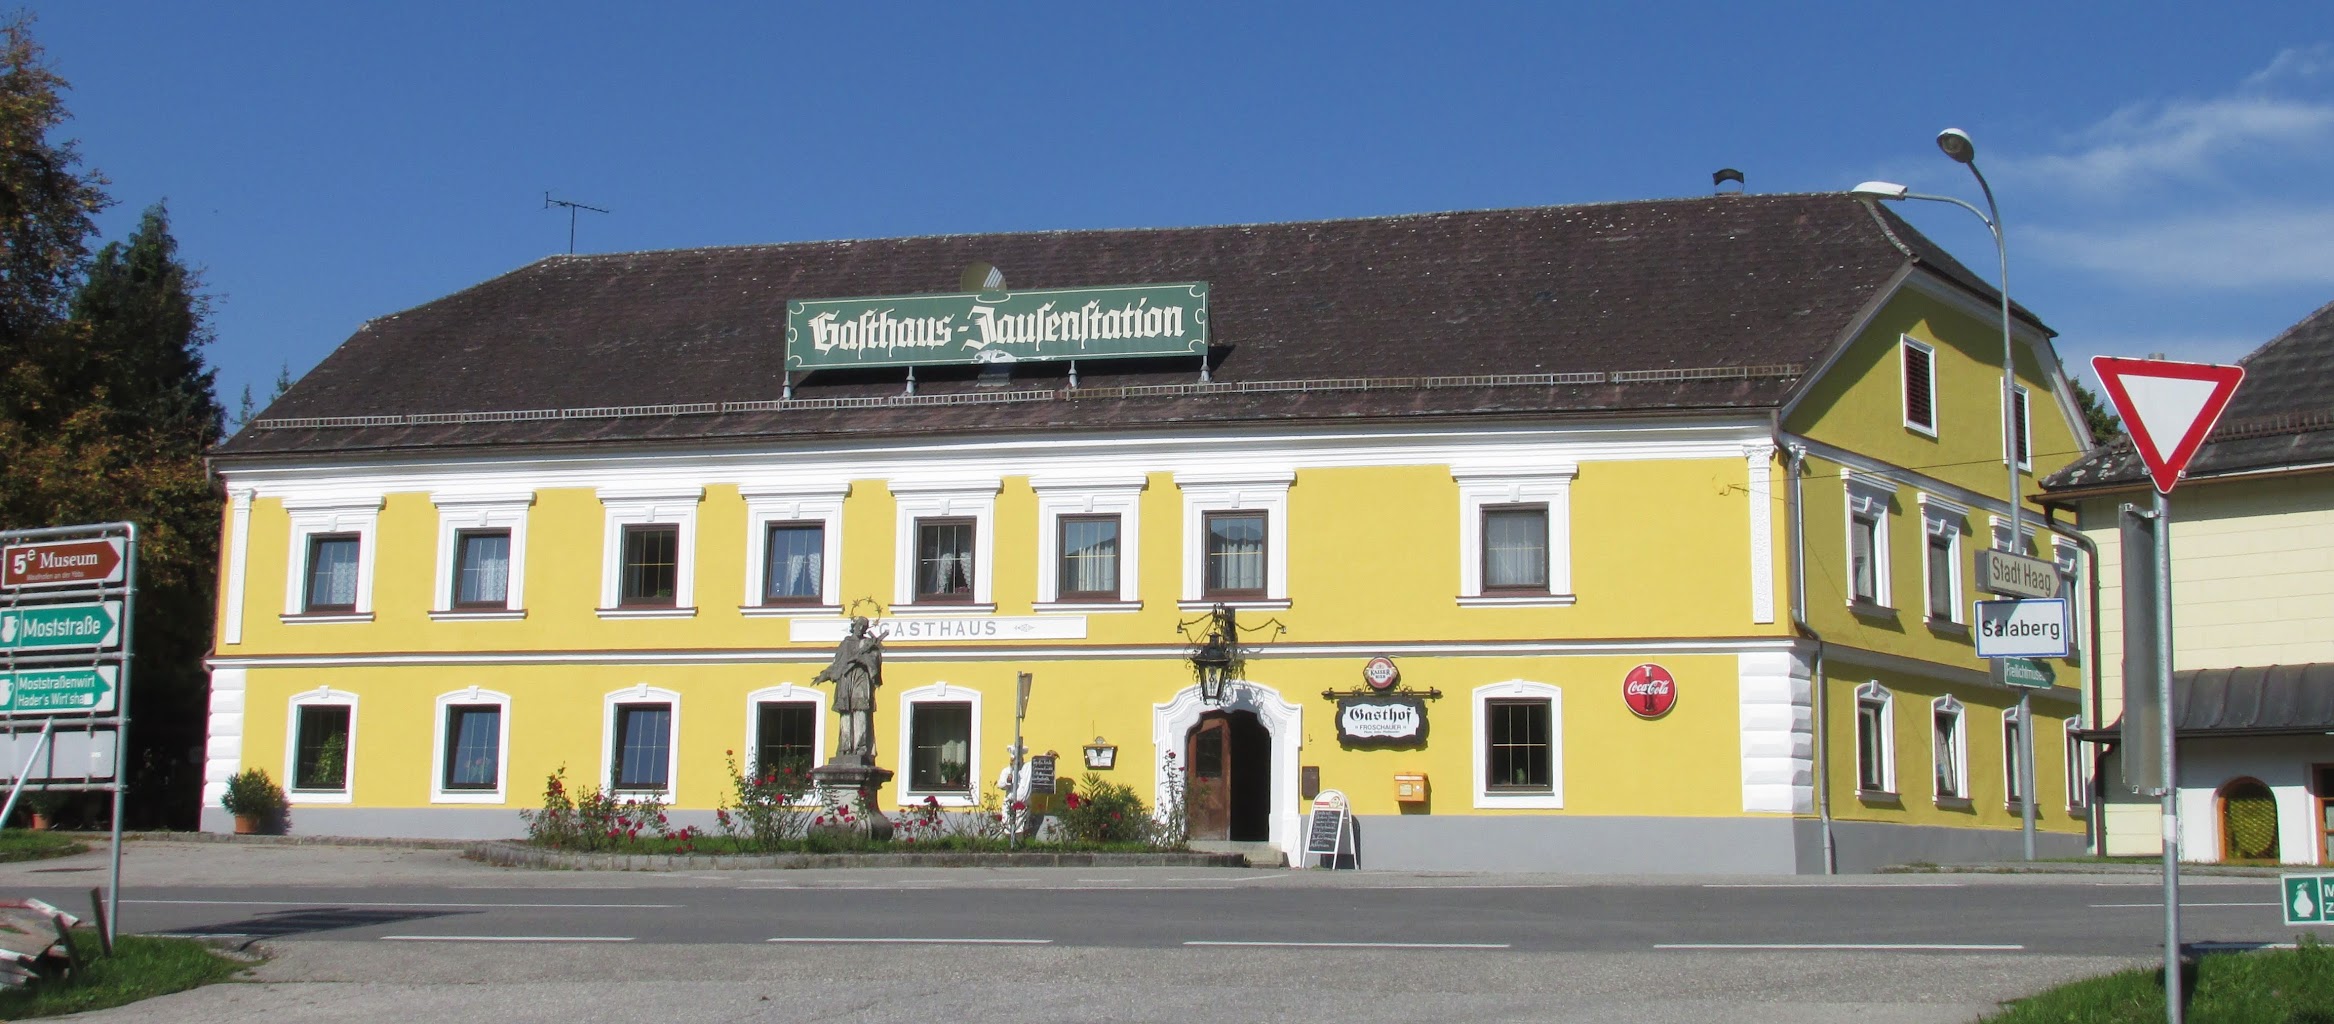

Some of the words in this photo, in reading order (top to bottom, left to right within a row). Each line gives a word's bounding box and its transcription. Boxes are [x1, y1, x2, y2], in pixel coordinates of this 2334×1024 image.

[39, 551, 99, 569] Museum
[1992, 556, 2022, 585] Stadt
[2023, 563, 2051, 598] Haag
[23, 616, 101, 638] Moststraße
[1982, 619, 2060, 640] Salaberg
[18, 675, 96, 690] Moststraßenwirt
[1349, 707, 1412, 725] Gasthof
